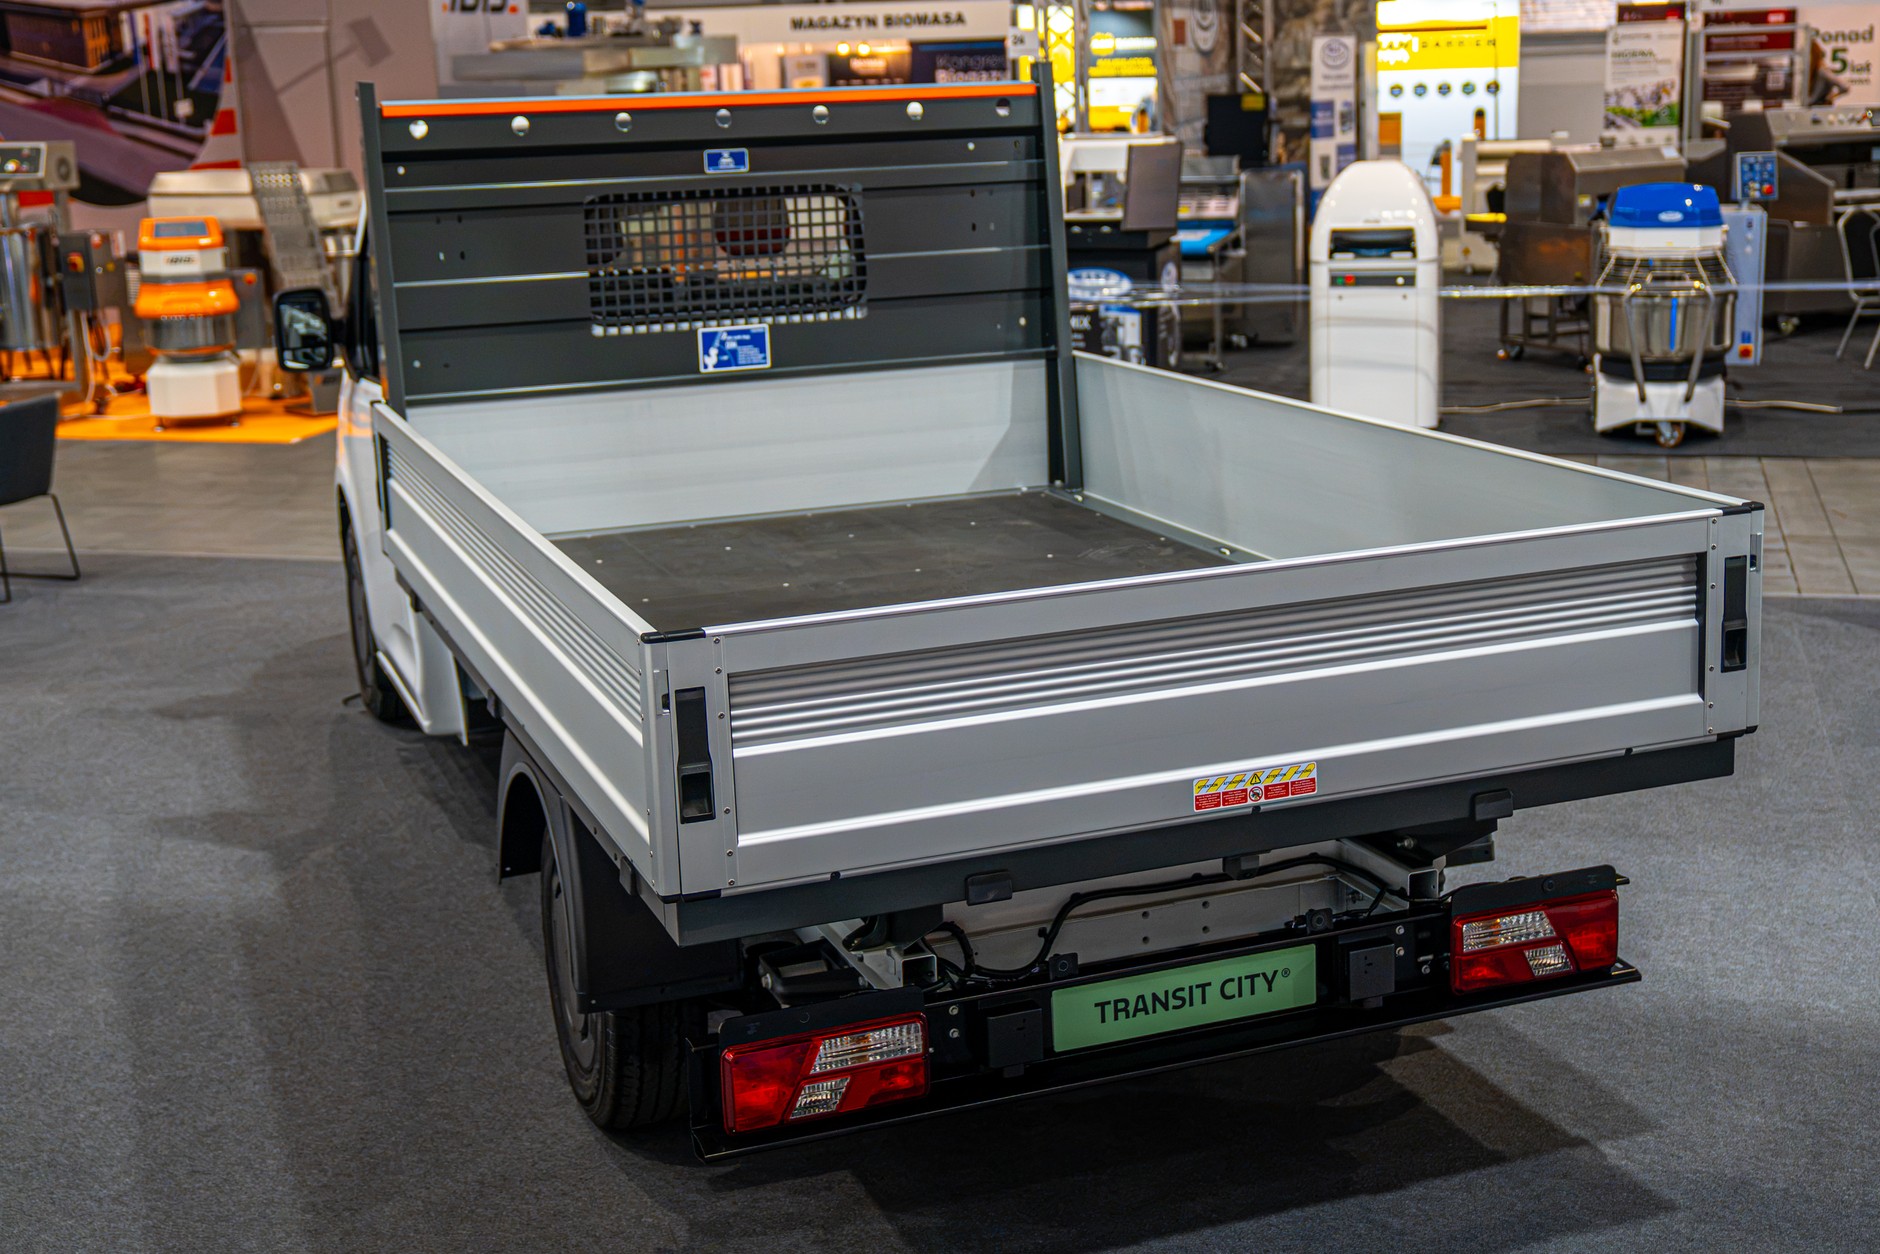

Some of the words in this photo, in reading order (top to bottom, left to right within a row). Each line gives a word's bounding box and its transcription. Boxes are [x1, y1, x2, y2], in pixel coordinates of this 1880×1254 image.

[790, 14, 877, 31] MAGAZYN
[883, 11, 967, 28] BIOMASA
[1094, 982, 1212, 1024] TRANSIT
